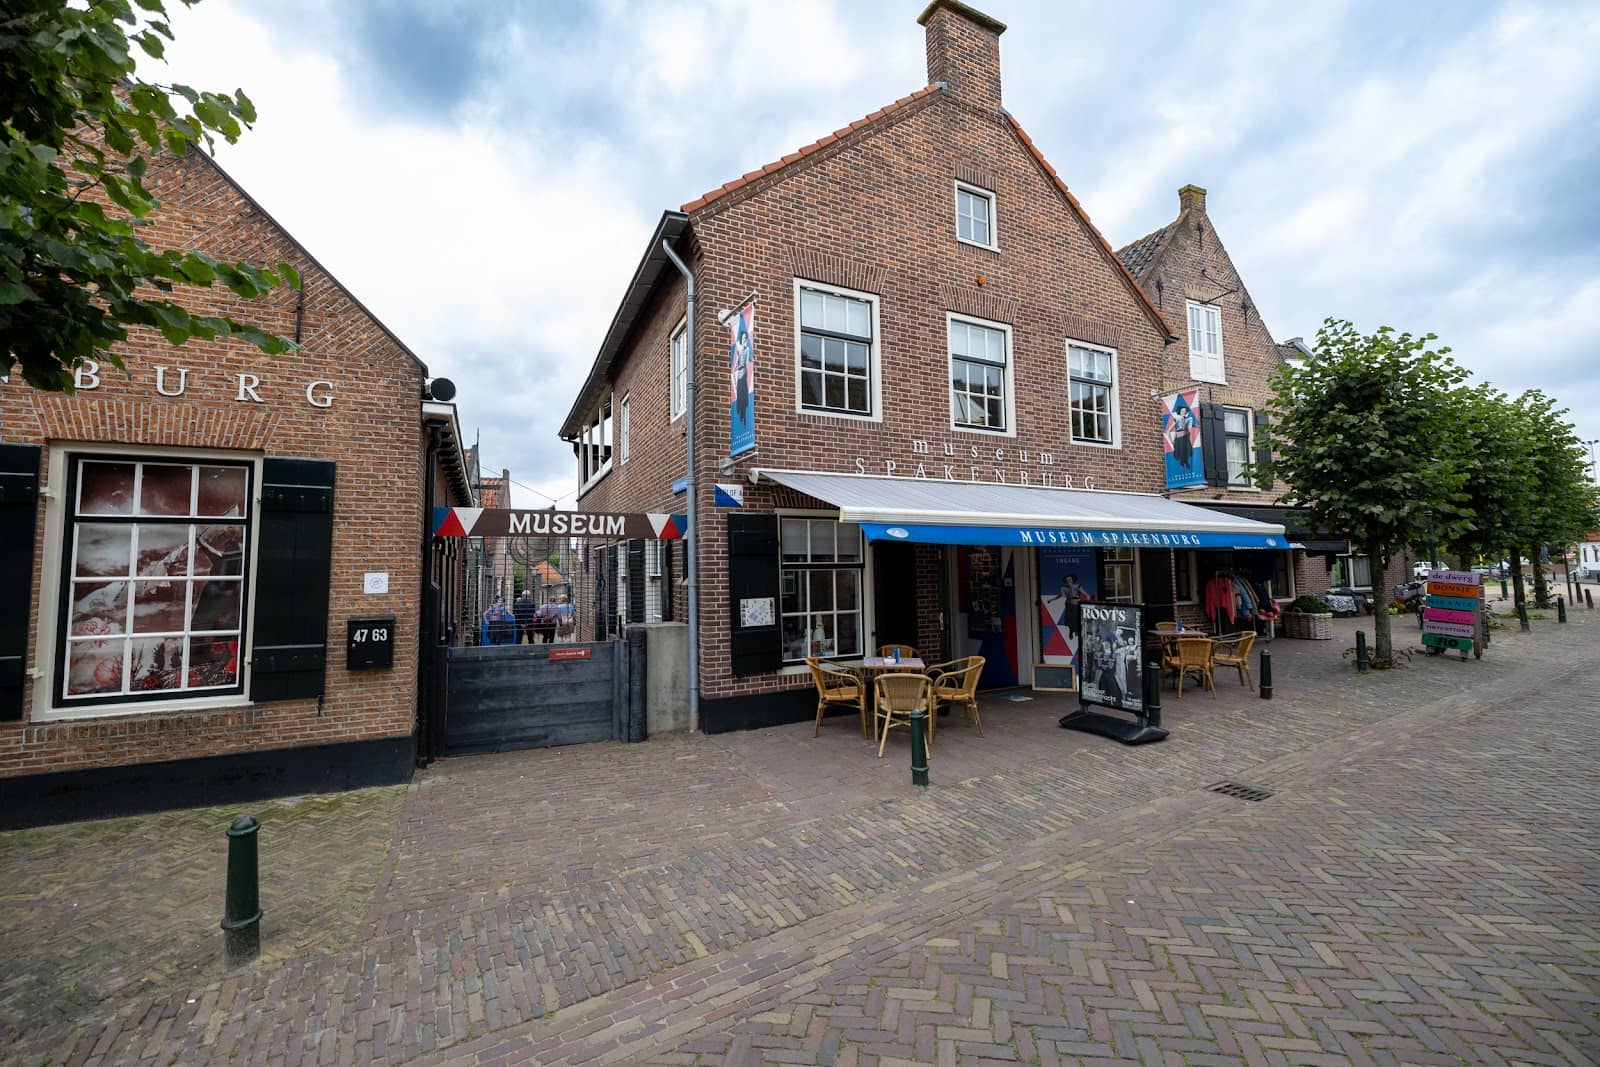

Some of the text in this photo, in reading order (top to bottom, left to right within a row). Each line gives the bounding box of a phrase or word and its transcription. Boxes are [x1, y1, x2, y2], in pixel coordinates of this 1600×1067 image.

[0, 355, 335, 408] BURG
[912, 440, 1053, 465] museum
[856, 457, 1094, 490] SPAKENBURG
[508, 513, 625, 535] MUSEUM
[1019, 530, 1200, 545] MUSEUM SPAKENBURG
[1446, 574, 1473, 583] dwerg
[1082, 607, 1126, 622] ROOTS
[354, 628, 388, 642] 47 63
